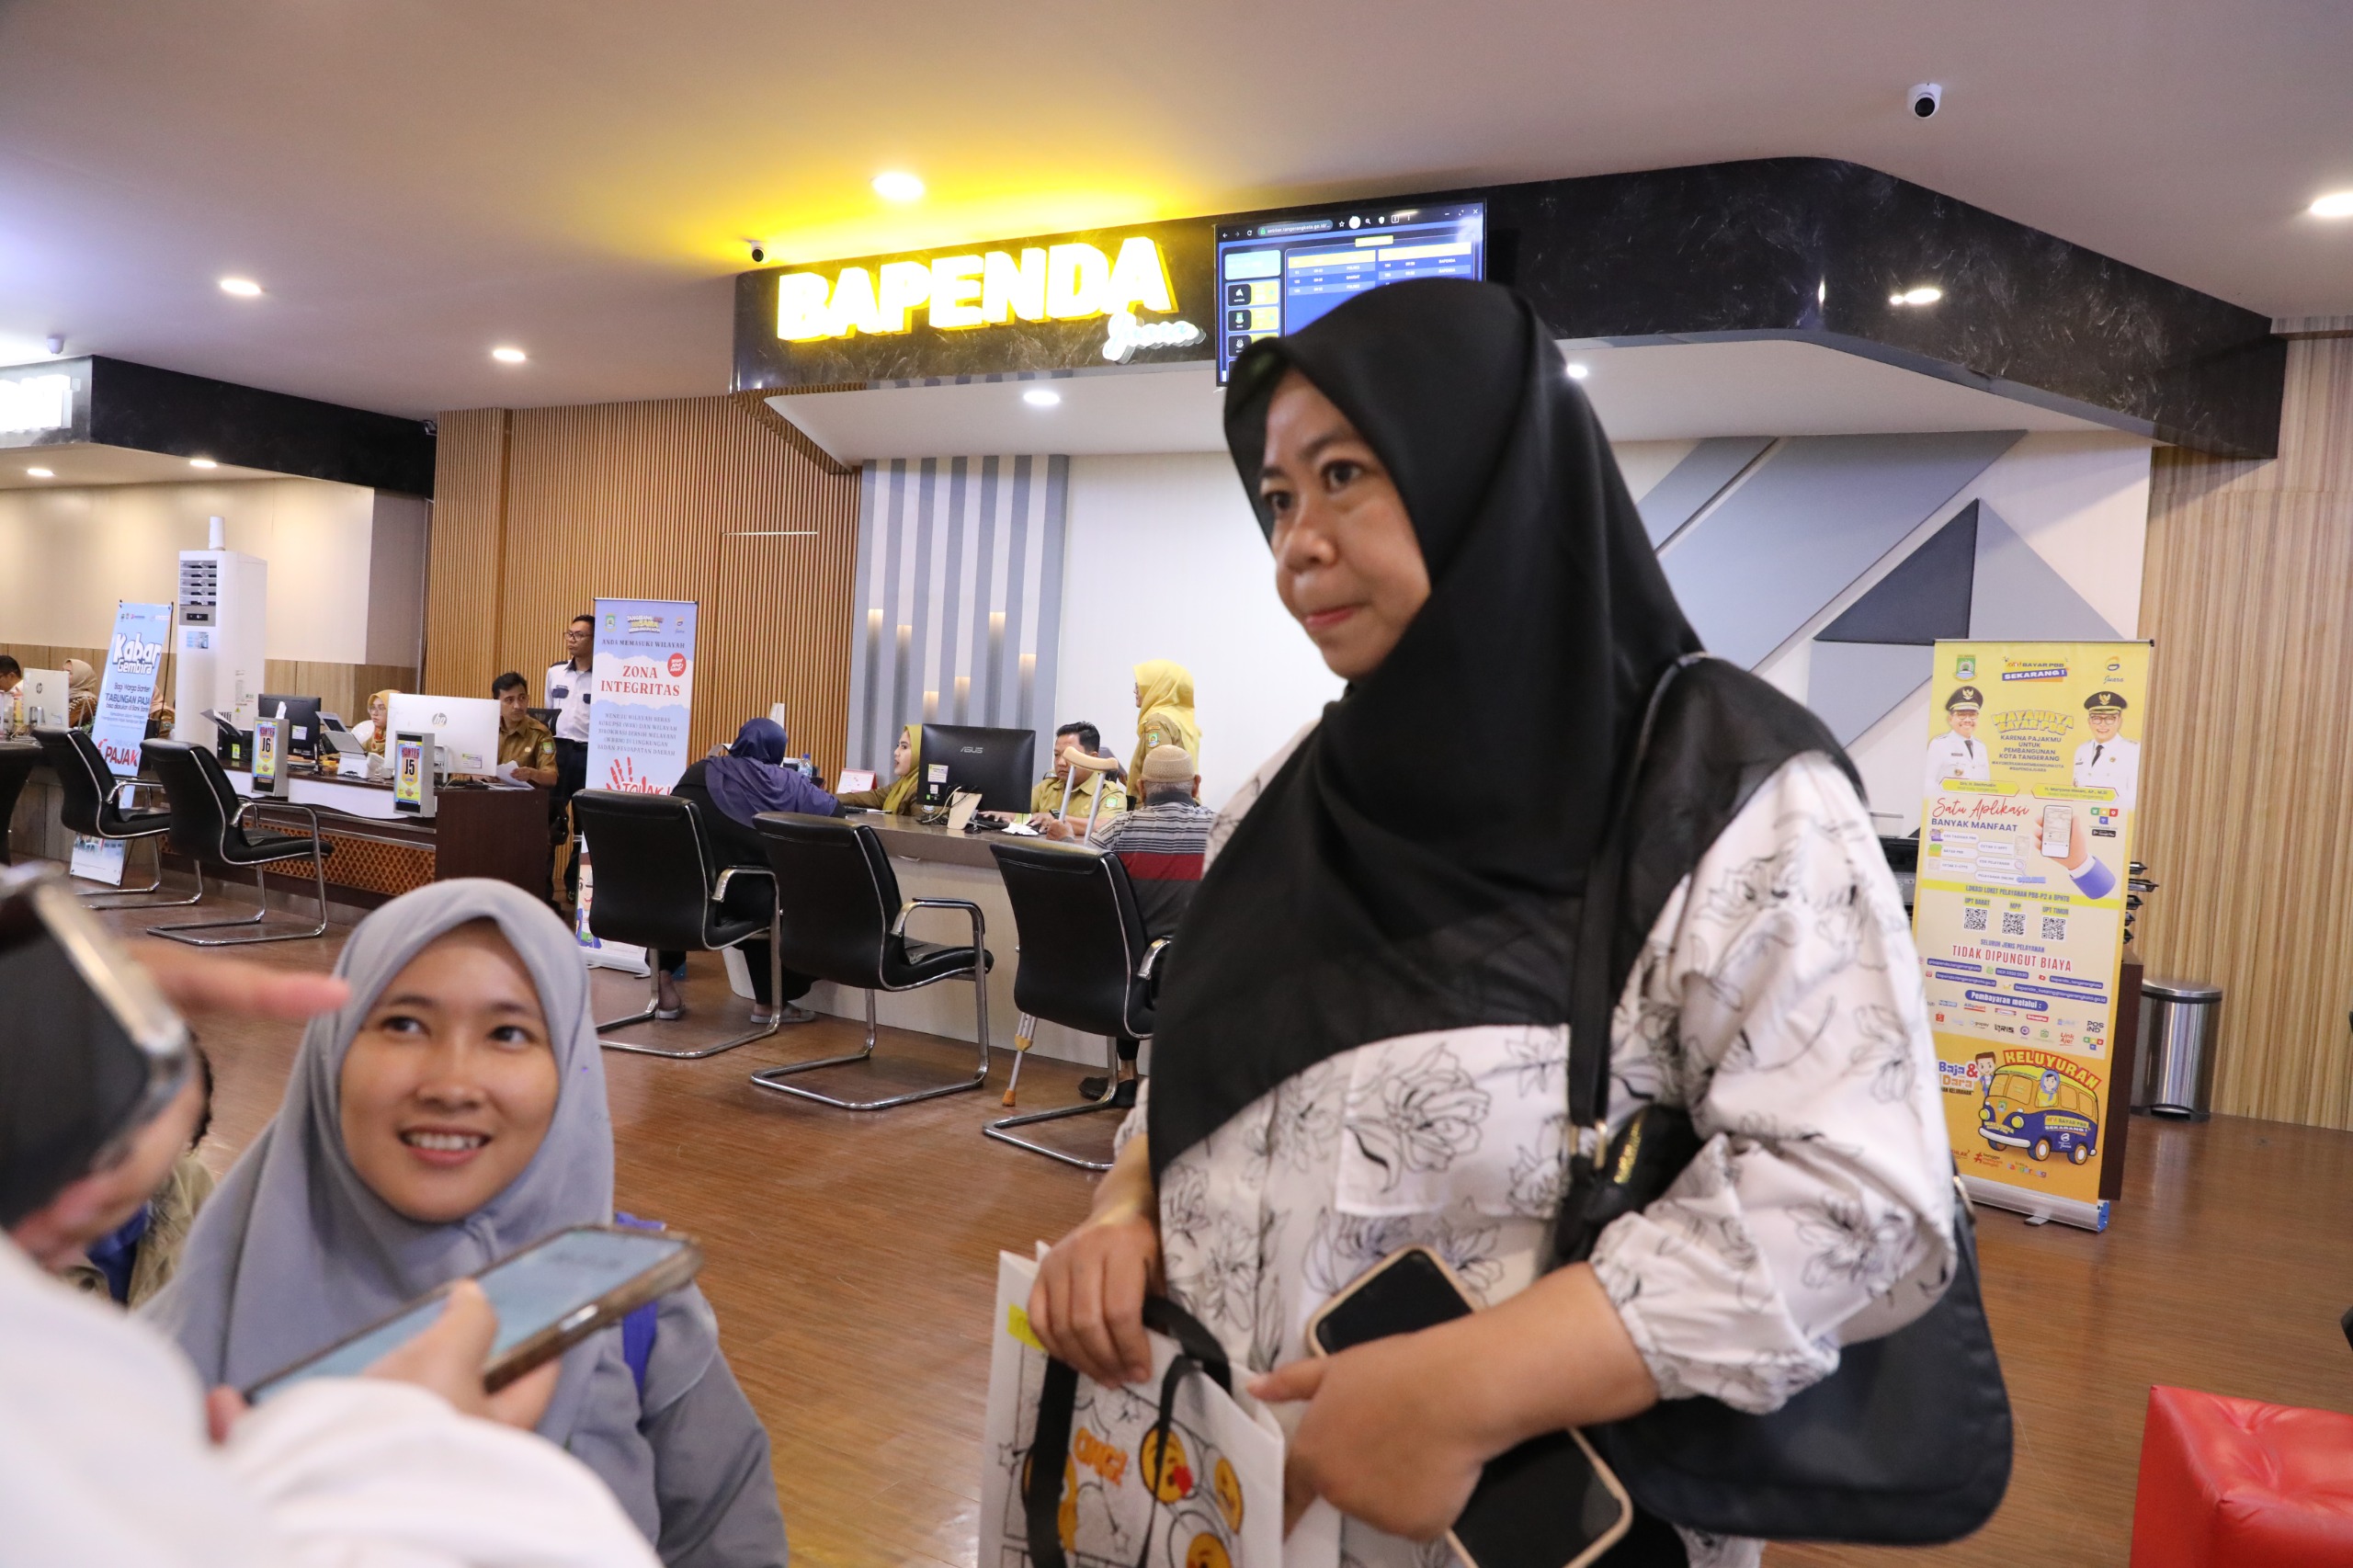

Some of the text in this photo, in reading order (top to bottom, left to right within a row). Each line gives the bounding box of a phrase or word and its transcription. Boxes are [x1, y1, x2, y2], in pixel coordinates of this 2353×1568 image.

[777, 236, 1179, 343] BAPENDA
[112, 632, 162, 667] Kabar
[117, 659, 153, 675] Gembira
[622, 665, 658, 678] ZONA
[2004, 670, 2060, 680] SEKARANG
[114, 682, 123, 692] Bagi
[600, 680, 680, 697] INTEGRITAS
[105, 692, 151, 705] TABUNGAN PAJA
[432, 712, 448, 728] hp
[262, 737, 271, 752] J6
[617, 745, 652, 754] PENDAPATAN
[632, 739, 668, 747] LINGKUNGAN
[104, 746, 140, 767] PAJAK
[404, 758, 415, 775] J5
[1932, 798, 2030, 821] Satu Aplikasi
[1931, 818, 2018, 832] BANYAK MANFAAT
[1984, 886, 1998, 894] LOKET
[1999, 888, 2028, 897] PELAYANAN
[2028, 892, 2048, 900] PBB-P2
[2042, 905, 2069, 915] UPT TIMUR
[1980, 938, 2045, 953] SELURUH JENIS PELAYANAN
[1952, 945, 2072, 971] TIDAK DIPUNGUT BIAYA
[1971, 992, 2011, 1006] Pembayaran
[2012, 998, 2038, 1009] melalui
[2087, 1020, 2104, 1028] POS
[1938, 1062, 1978, 1078] Baja &
[2005, 1051, 2100, 1088] KELUYURAN
[1942, 1074, 1972, 1088] Dara
